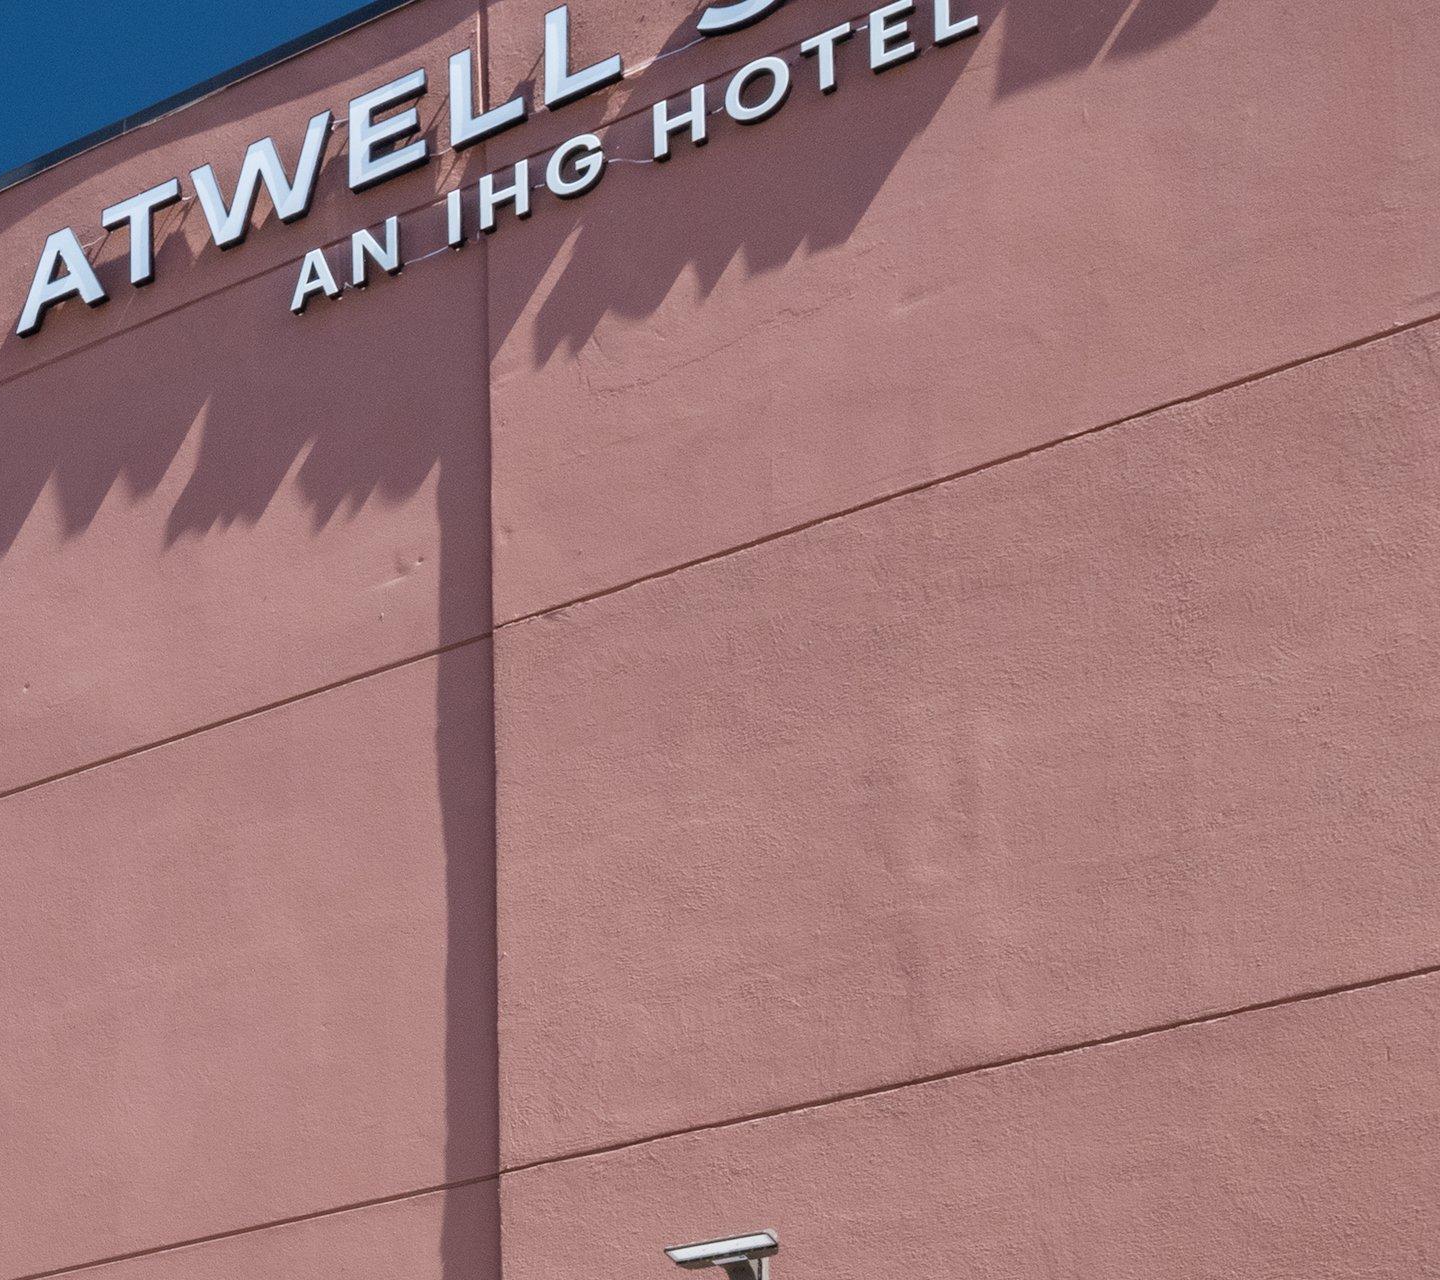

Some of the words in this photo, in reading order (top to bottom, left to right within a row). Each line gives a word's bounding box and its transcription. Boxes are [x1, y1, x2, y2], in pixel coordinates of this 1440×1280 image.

[16, 7, 623, 336] ATWELL
[290, 215, 400, 314] AN
[446, 133, 606, 249] IHG
[652, 0, 979, 163] HOTEL
